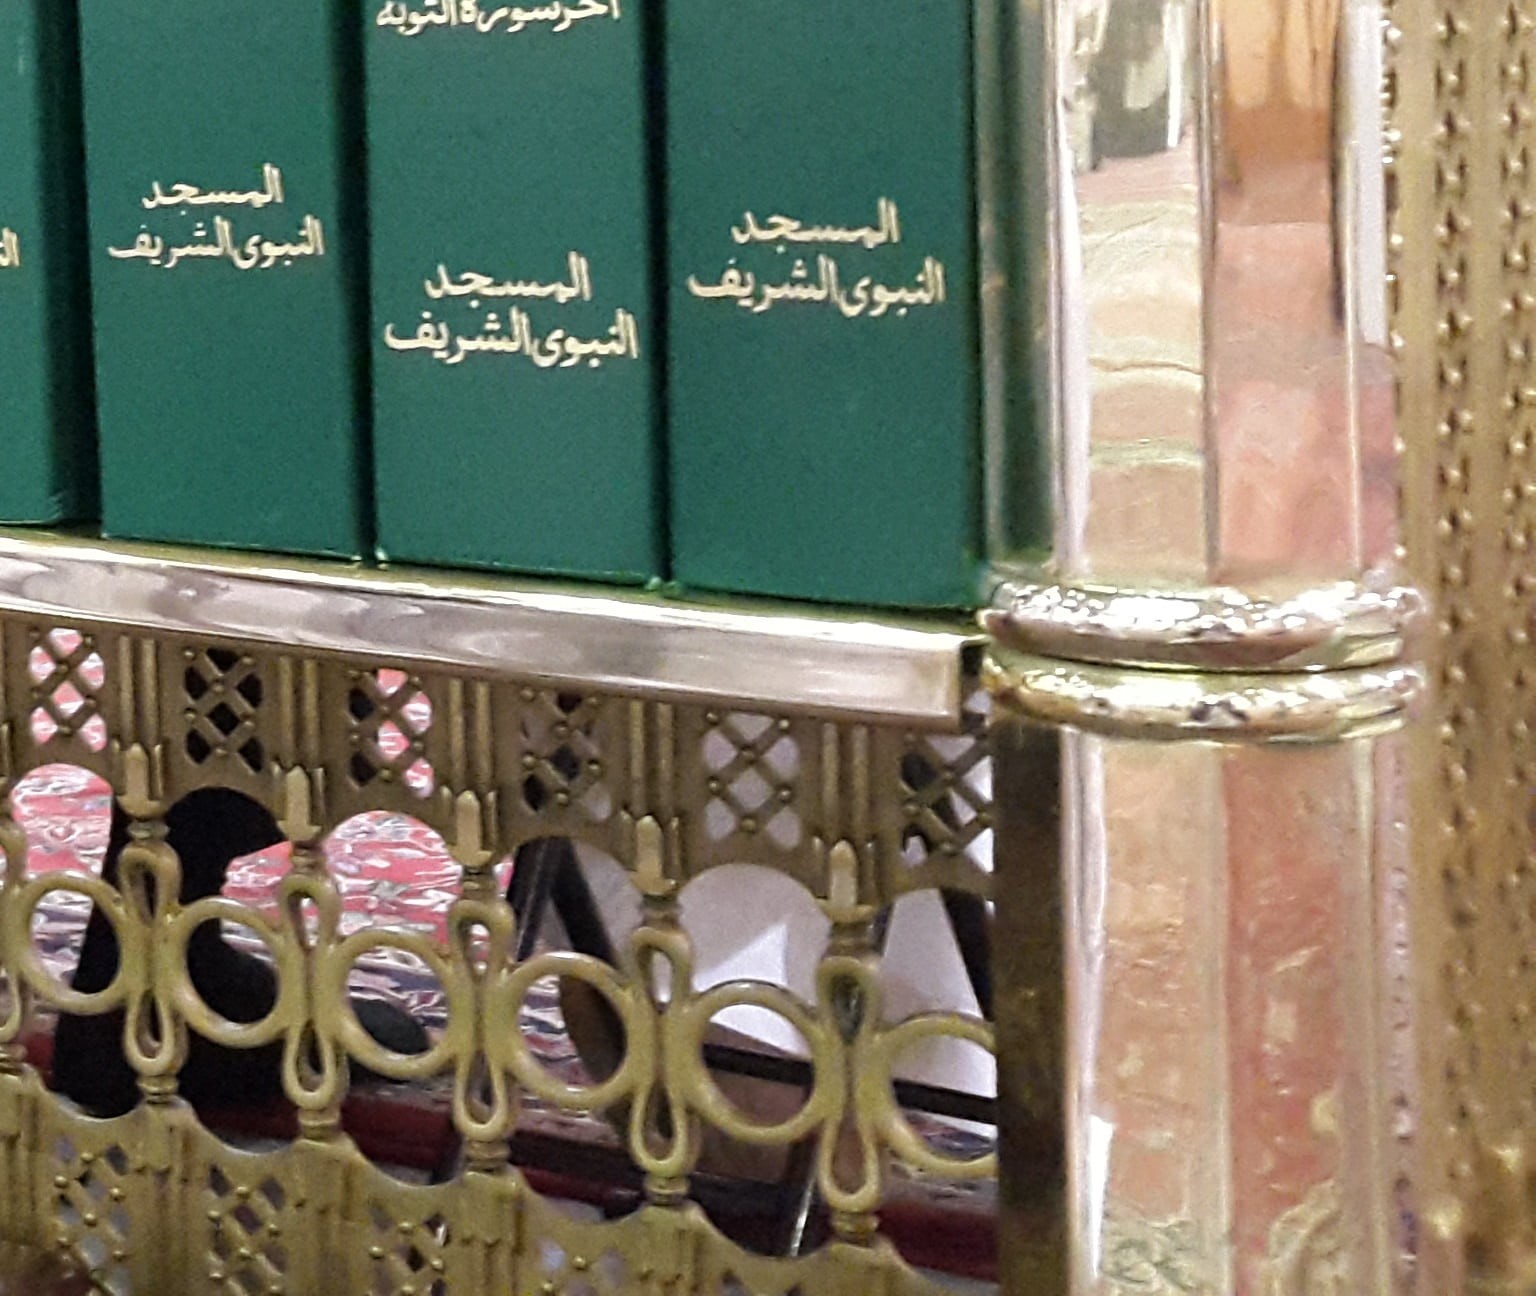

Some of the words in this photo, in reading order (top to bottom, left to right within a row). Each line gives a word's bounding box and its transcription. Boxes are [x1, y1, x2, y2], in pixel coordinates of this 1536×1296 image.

[141, 162, 284, 218] المسجد
[107, 213, 236, 269] الشريف
[731, 197, 900, 254] المسجد
[424, 251, 592, 311] المسجد
[687, 254, 841, 313] الشريف
[384, 304, 533, 364] الشريف
